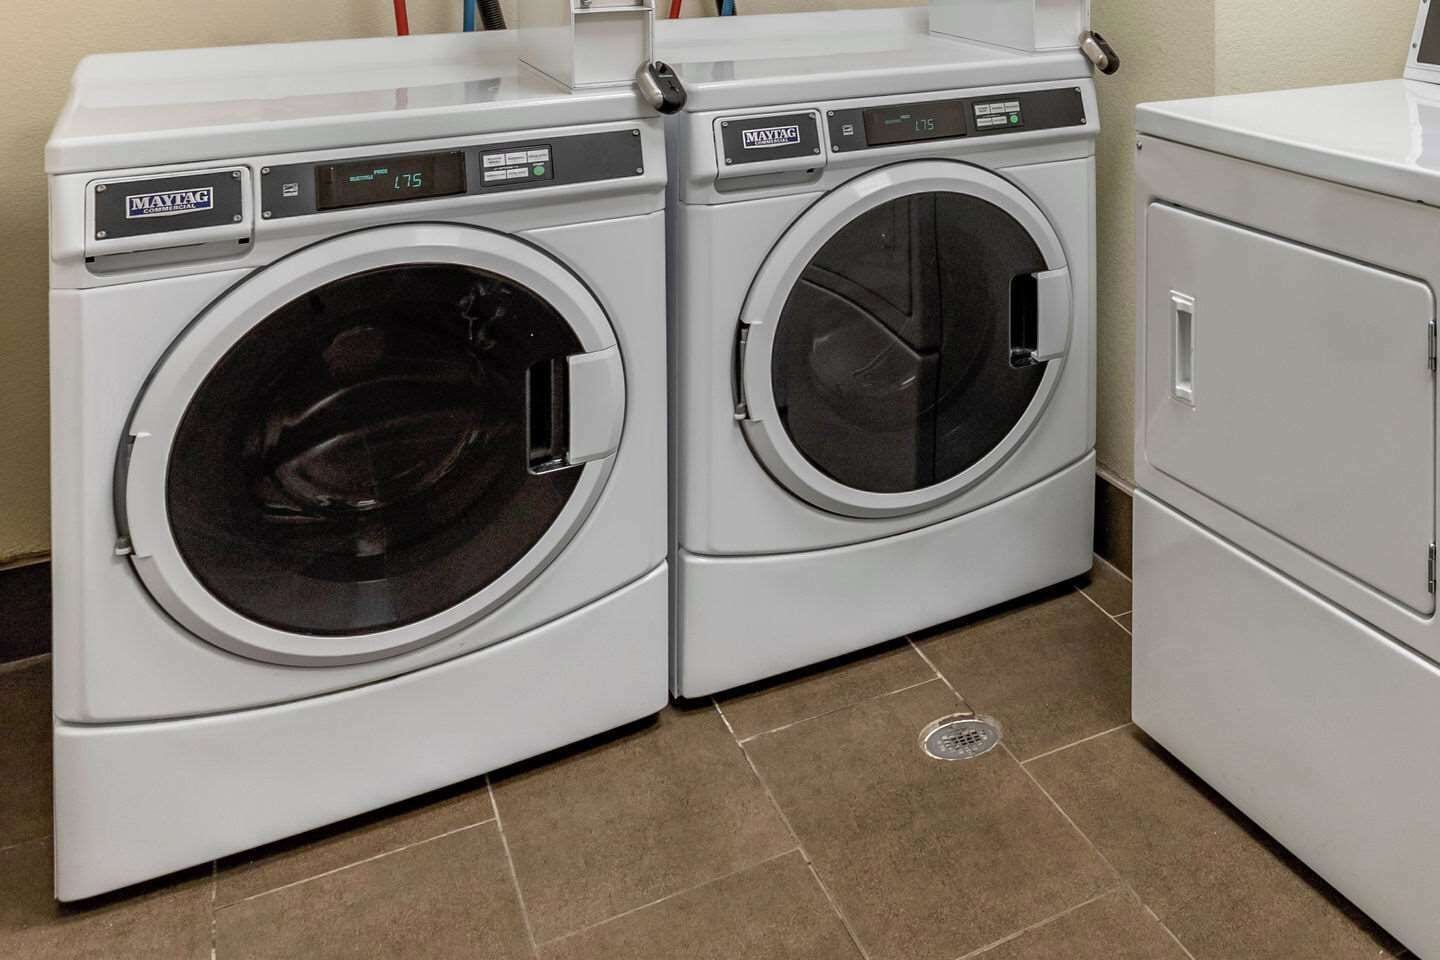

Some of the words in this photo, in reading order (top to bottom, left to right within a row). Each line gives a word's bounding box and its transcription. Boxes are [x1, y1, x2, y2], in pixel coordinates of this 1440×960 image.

[745, 128, 796, 143] MAYTAG
[130, 190, 209, 211] MAYTAG
[143, 203, 197, 214] COMMERCIAL
